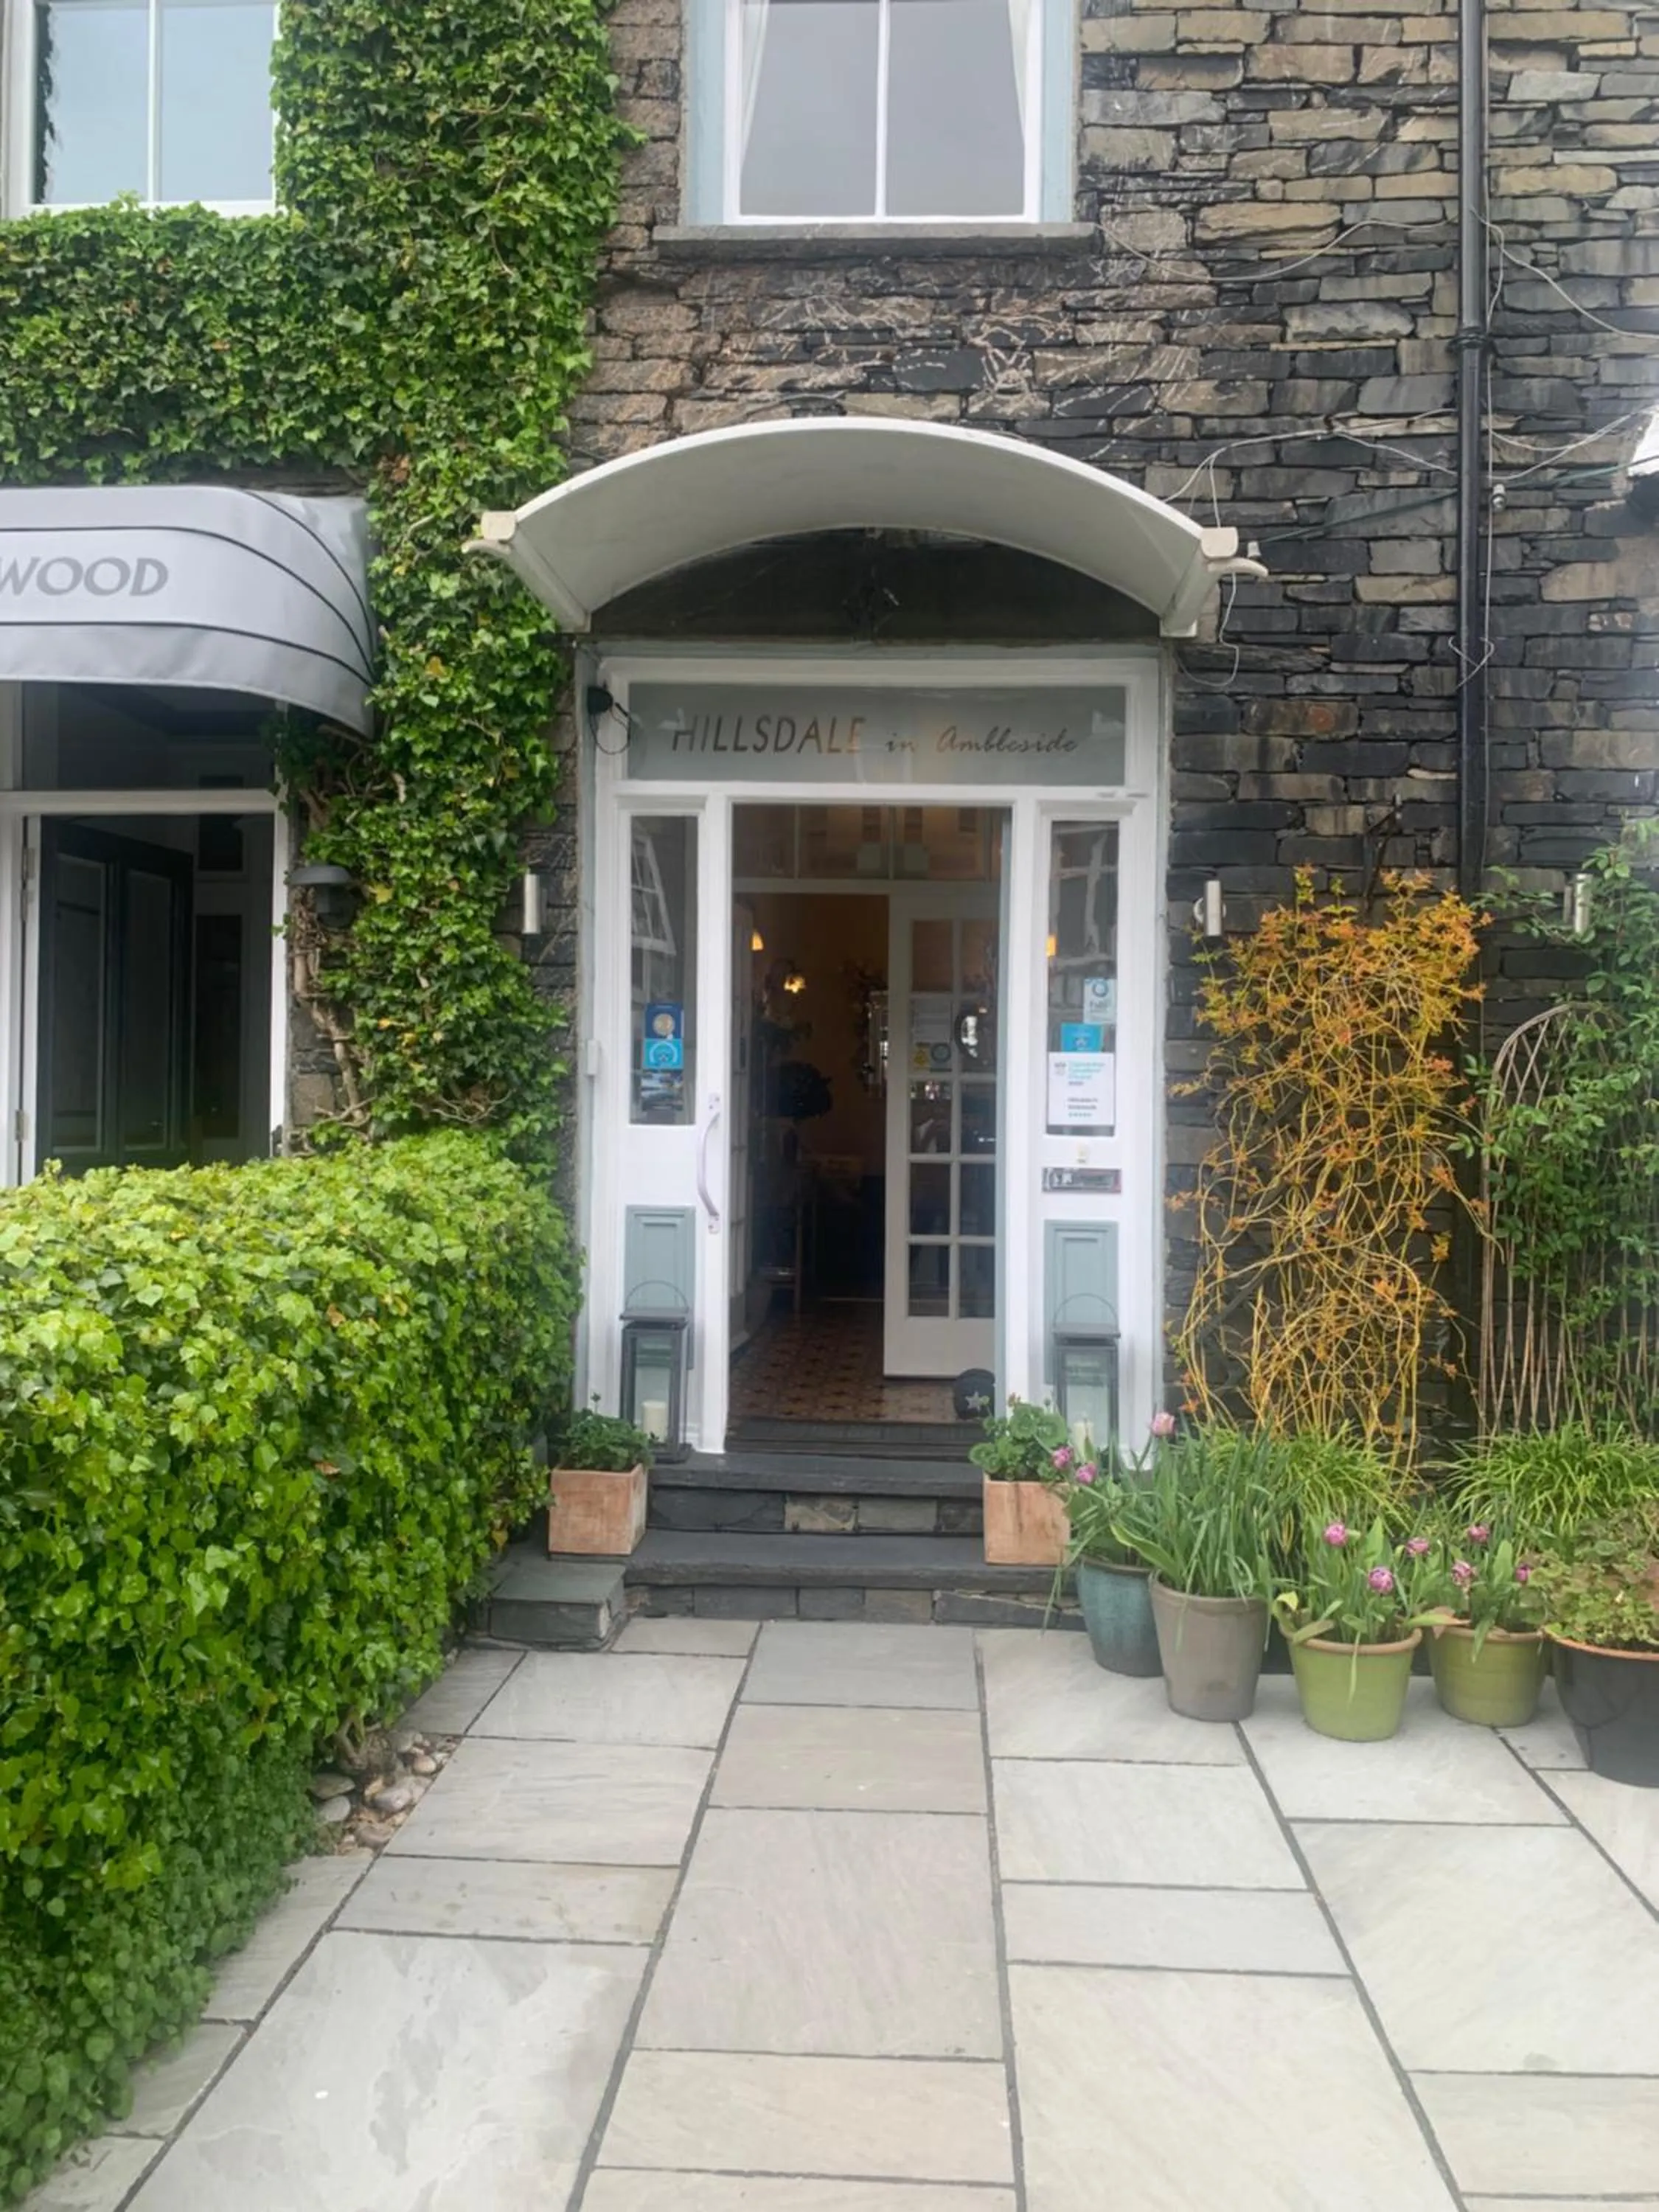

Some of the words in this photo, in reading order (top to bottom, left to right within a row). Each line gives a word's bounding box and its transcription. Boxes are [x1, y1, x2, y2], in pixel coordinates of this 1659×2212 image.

[0, 556, 169, 597] WOOD
[672, 714, 866, 754] HILLSDALE
[886, 732, 915, 752] in
[936, 726, 1077, 753] Ambleside
